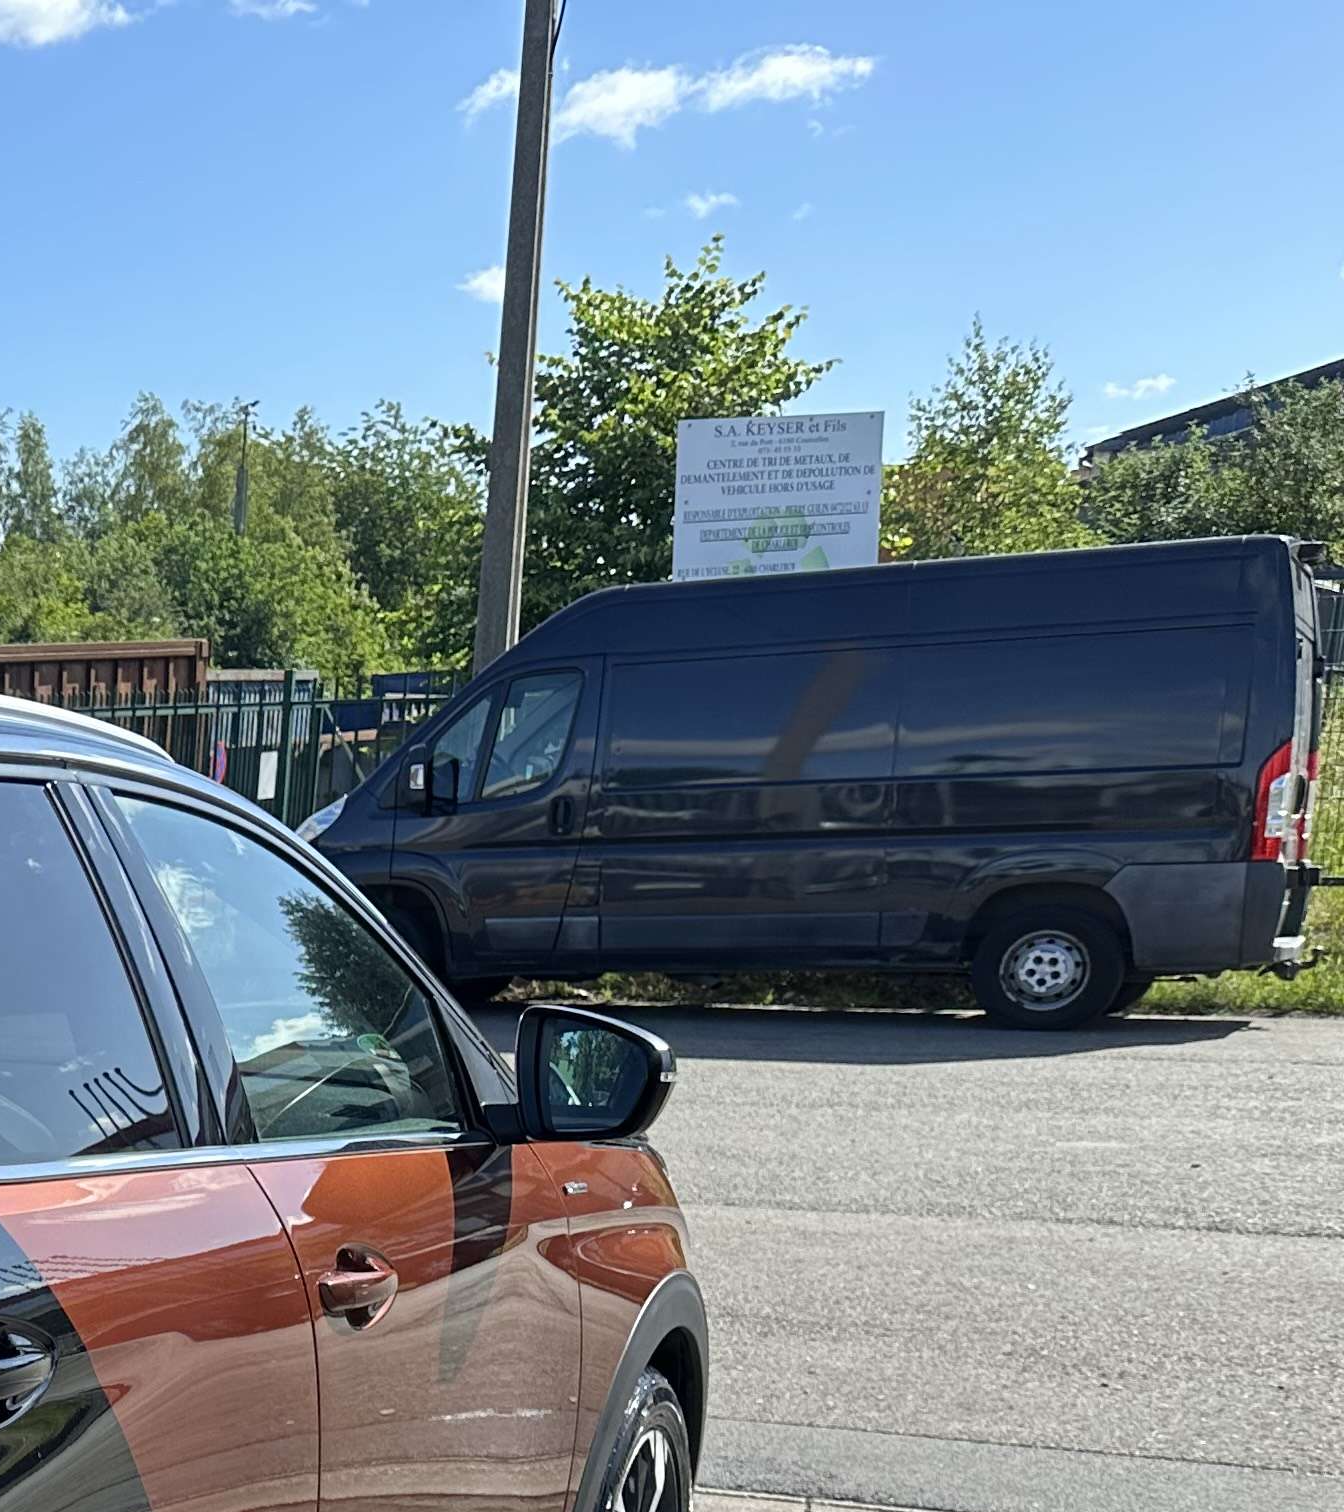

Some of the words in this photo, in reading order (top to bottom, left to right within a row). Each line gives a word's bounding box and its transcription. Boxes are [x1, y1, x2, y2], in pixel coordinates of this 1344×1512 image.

[714, 425, 741, 438] S.A.
[745, 421, 804, 437] KEYSER
[808, 422, 820, 433] et
[824, 419, 847, 433] Fils
[706, 458, 745, 470] CENTRE
[747, 457, 759, 468] DE
[760, 456, 777, 467] TRI
[779, 455, 792, 466] DE
[838, 452, 851, 463] DE
[680, 471, 765, 484] DEMANTELEMENT
[767, 470, 779, 480] ET
[781, 468, 794, 479] DE
[796, 465, 861, 478] DEPOLLUTION
[863, 464, 875, 475] DE
[720, 483, 767, 495] VEHICULE
[768, 481, 794, 493] HORS
[796, 479, 835, 491] D'USAGE
